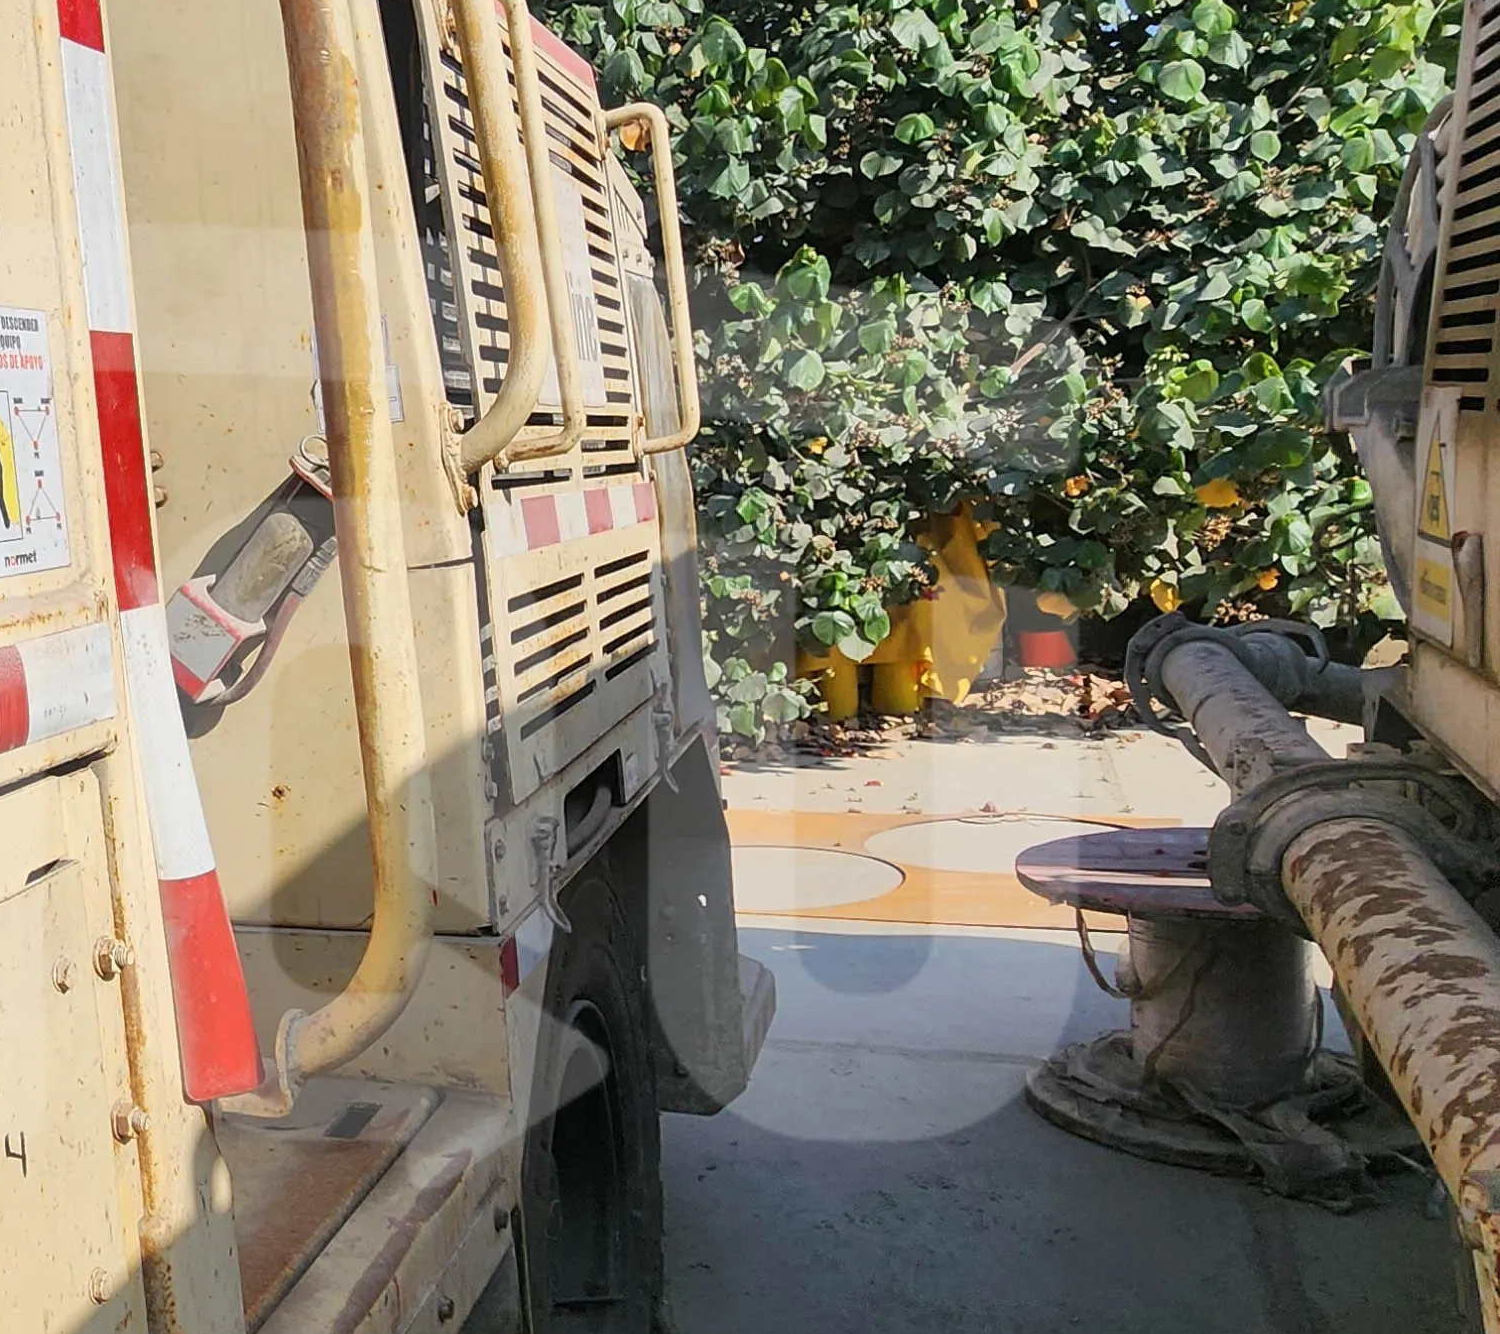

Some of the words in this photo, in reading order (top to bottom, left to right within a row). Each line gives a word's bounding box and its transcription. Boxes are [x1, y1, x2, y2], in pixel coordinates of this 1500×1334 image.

[0, 315, 39, 332] DESCENDER
[9, 353, 19, 369] DE
[20, 354, 44, 371] APOYO
[4, 549, 37, 568] normet
